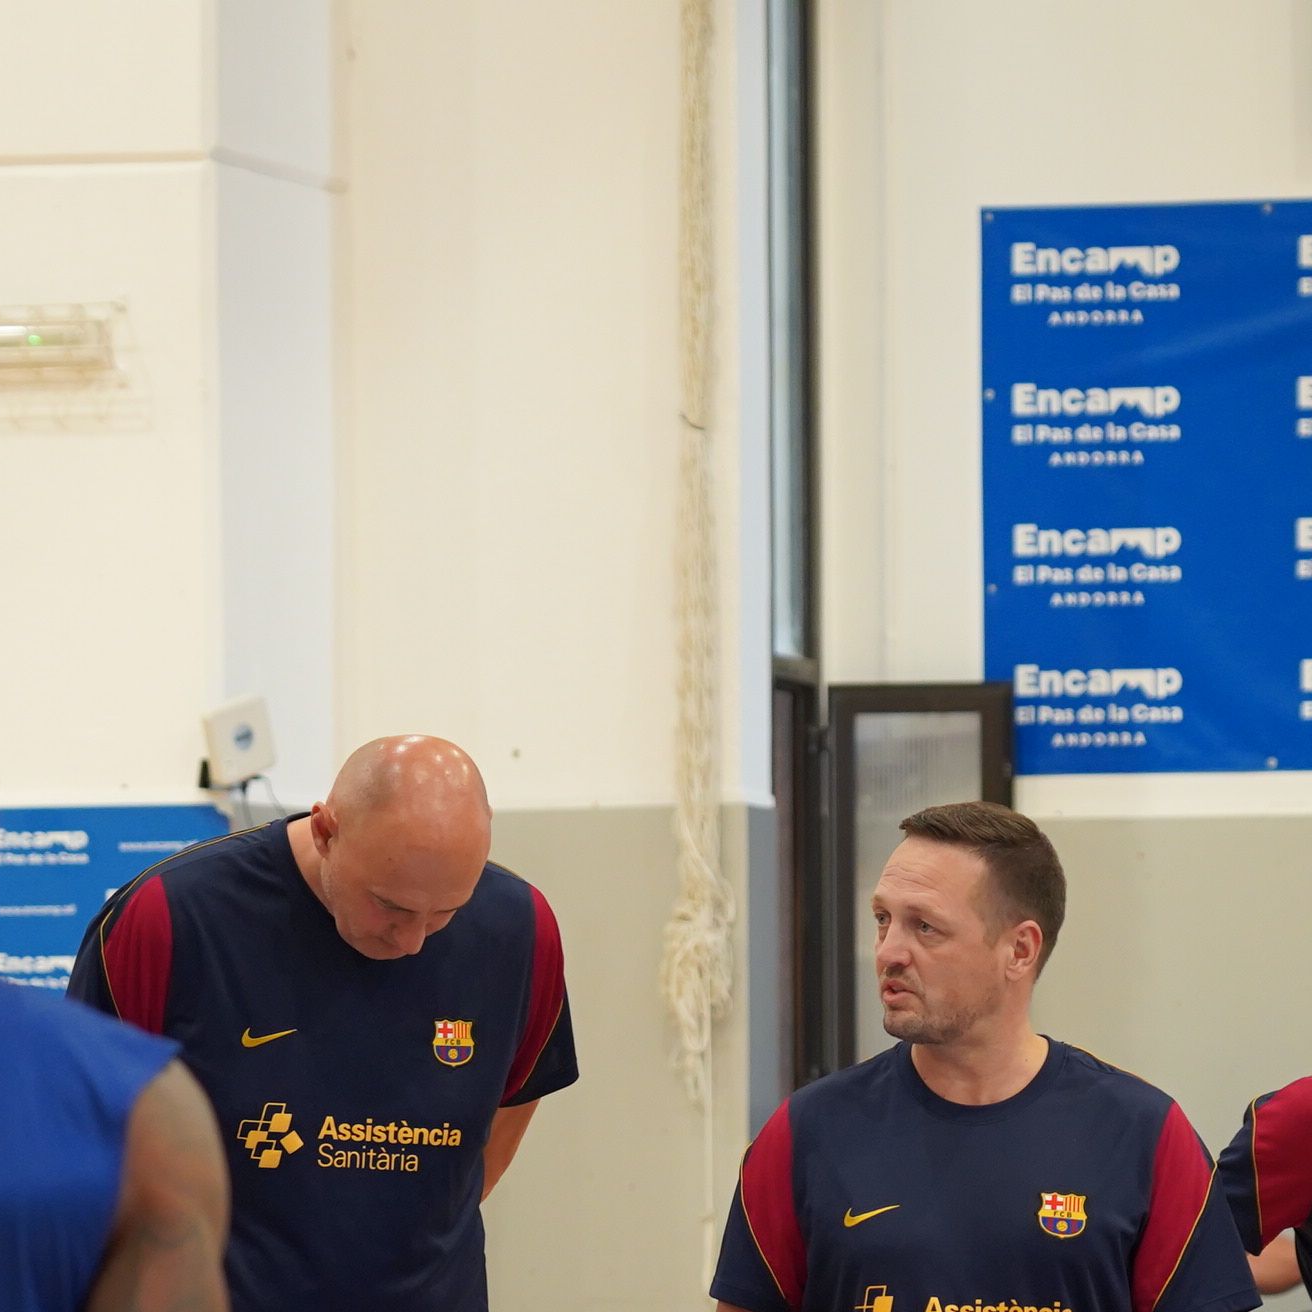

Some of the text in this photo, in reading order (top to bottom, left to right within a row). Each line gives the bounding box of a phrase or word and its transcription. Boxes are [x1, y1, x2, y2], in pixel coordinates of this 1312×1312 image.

[1011, 242, 1180, 276] Encamp
[1011, 281, 1180, 303] El Pas de la Casa
[1048, 309, 1143, 326] ANDORRA
[1011, 383, 1180, 417] Encamp
[1012, 422, 1181, 444] El Pas de la Casa
[1049, 451, 1144, 466] ANDORRA
[1013, 524, 1181, 559] Encamp
[1013, 563, 1182, 585] El Pas de la Casa
[1050, 591, 1144, 606] ANDORRA
[1013, 664, 1183, 699] Encamp
[1015, 704, 1183, 725] El Pas de la Casa
[1052, 732, 1146, 747] ANDORRA
[317, 1115, 462, 1147] Assistència
[317, 1143, 419, 1172] Sanitària
